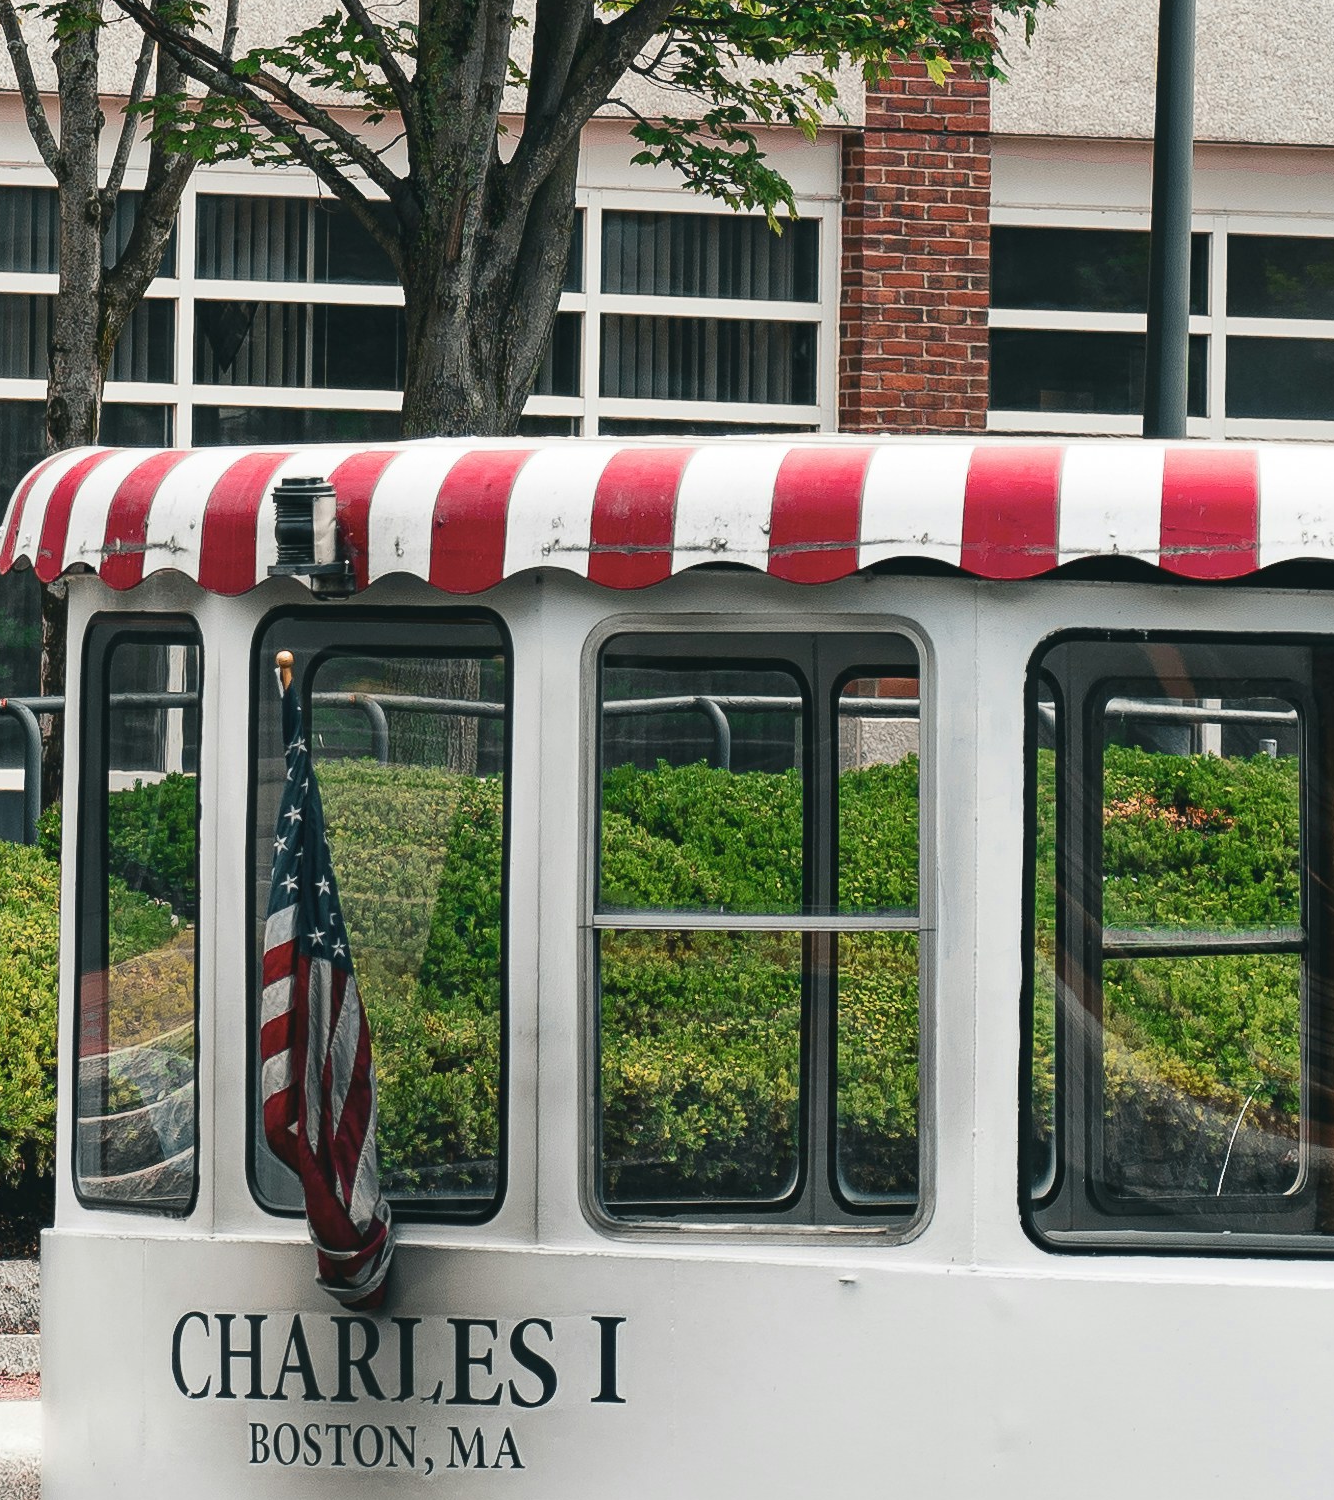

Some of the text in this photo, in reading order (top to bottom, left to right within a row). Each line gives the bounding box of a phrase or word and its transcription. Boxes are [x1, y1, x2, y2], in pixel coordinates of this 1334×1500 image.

[171, 1310, 627, 1409] CHARLES I
[248, 1422, 526, 1476] BOSTON, MA
